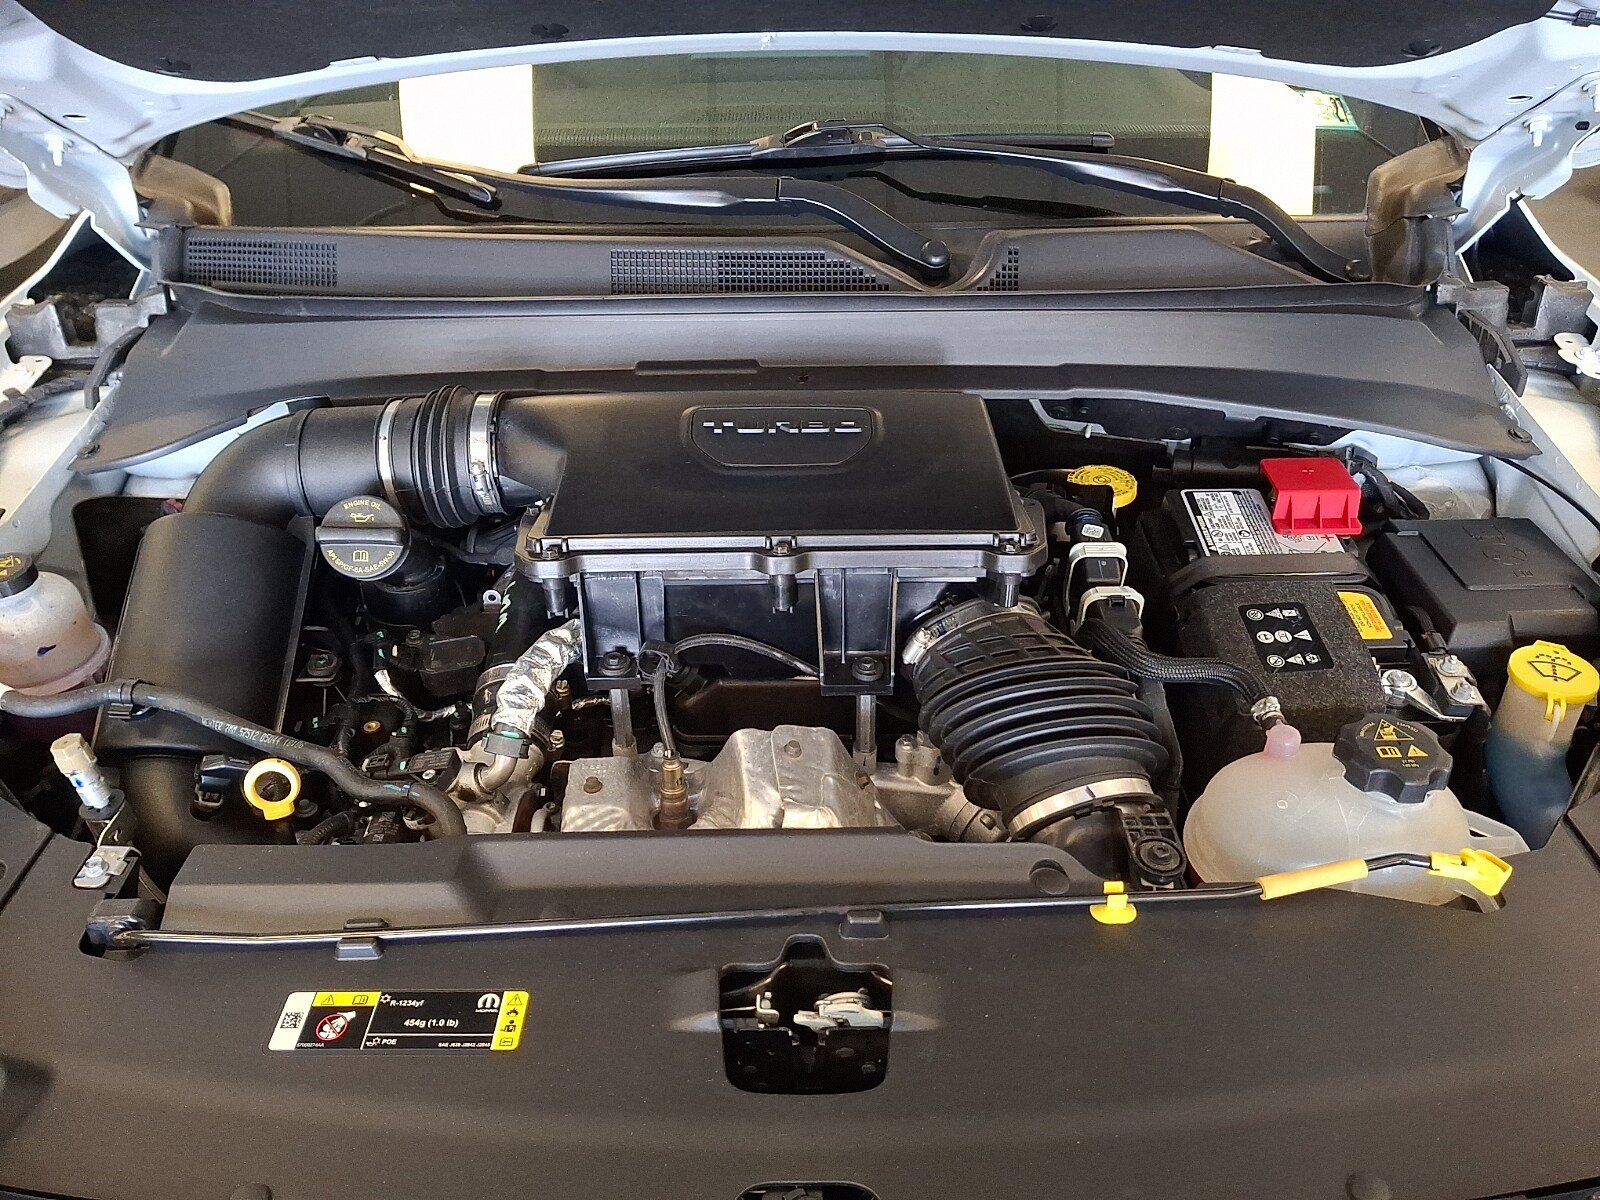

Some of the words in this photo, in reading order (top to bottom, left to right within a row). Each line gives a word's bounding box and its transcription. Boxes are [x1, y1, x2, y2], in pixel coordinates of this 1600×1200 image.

[702, 420, 862, 434] TURBO
[343, 499, 370, 510] ENGINE
[370, 500, 381, 510] OIL
[326, 549, 338, 561] API
[389, 999, 425, 1008] R-1234yf
[403, 1018, 427, 1029] 454g
[427, 1018, 444, 1028] (1.0
[445, 1018, 459, 1028] lb)
